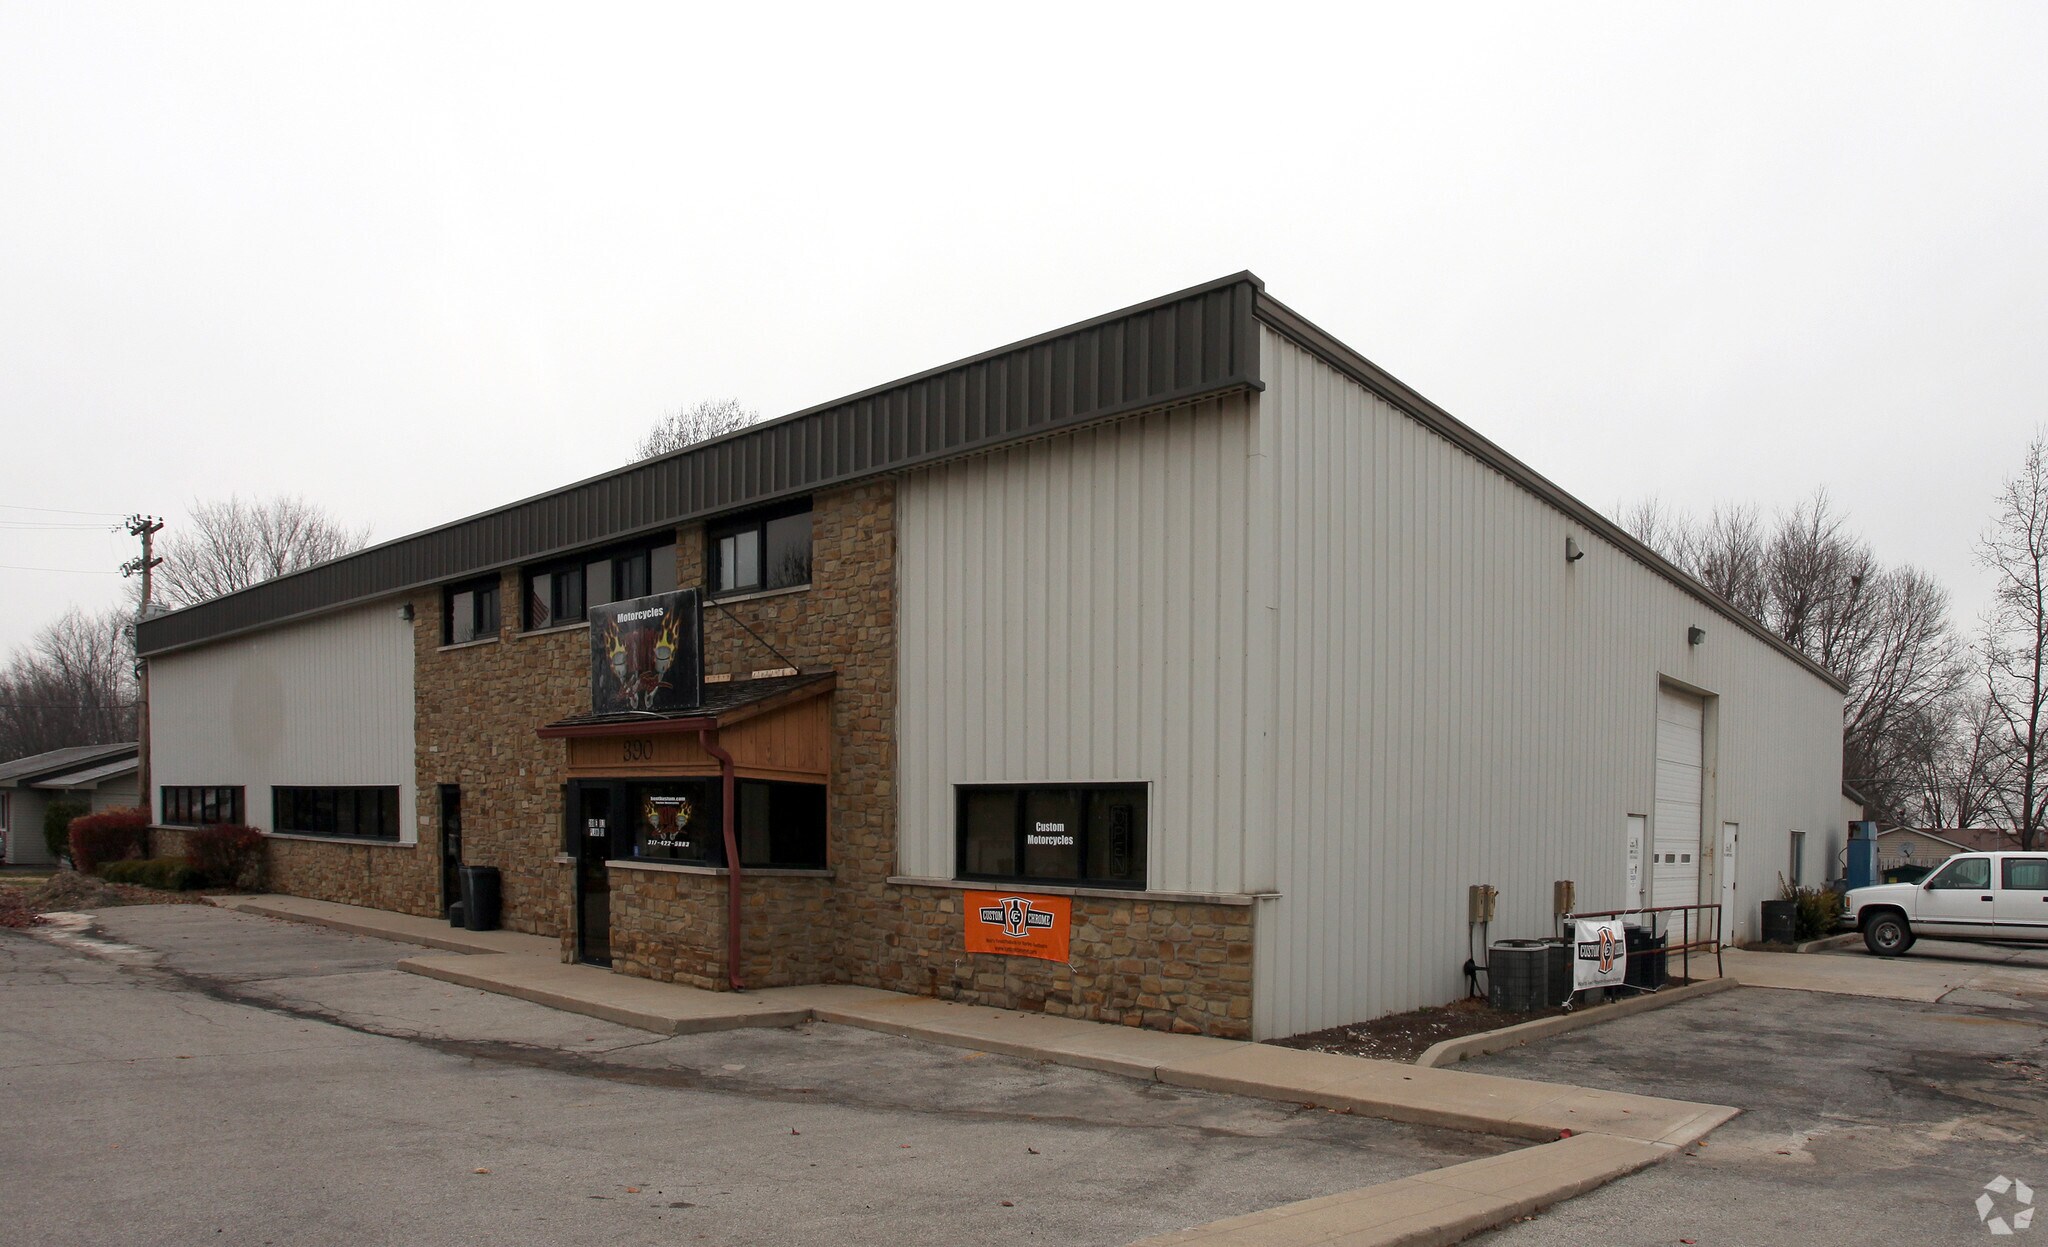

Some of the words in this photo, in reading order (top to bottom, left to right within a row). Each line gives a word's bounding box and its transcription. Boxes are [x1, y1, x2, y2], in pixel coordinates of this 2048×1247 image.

[617, 607, 664, 623] Motorcycles
[623, 739, 654, 761] 390
[1035, 821, 1065, 832] Custom
[1027, 834, 1074, 846] Motorcycles
[982, 910, 1004, 921] CUSTOM
[1027, 912, 1051, 926] CHROME
